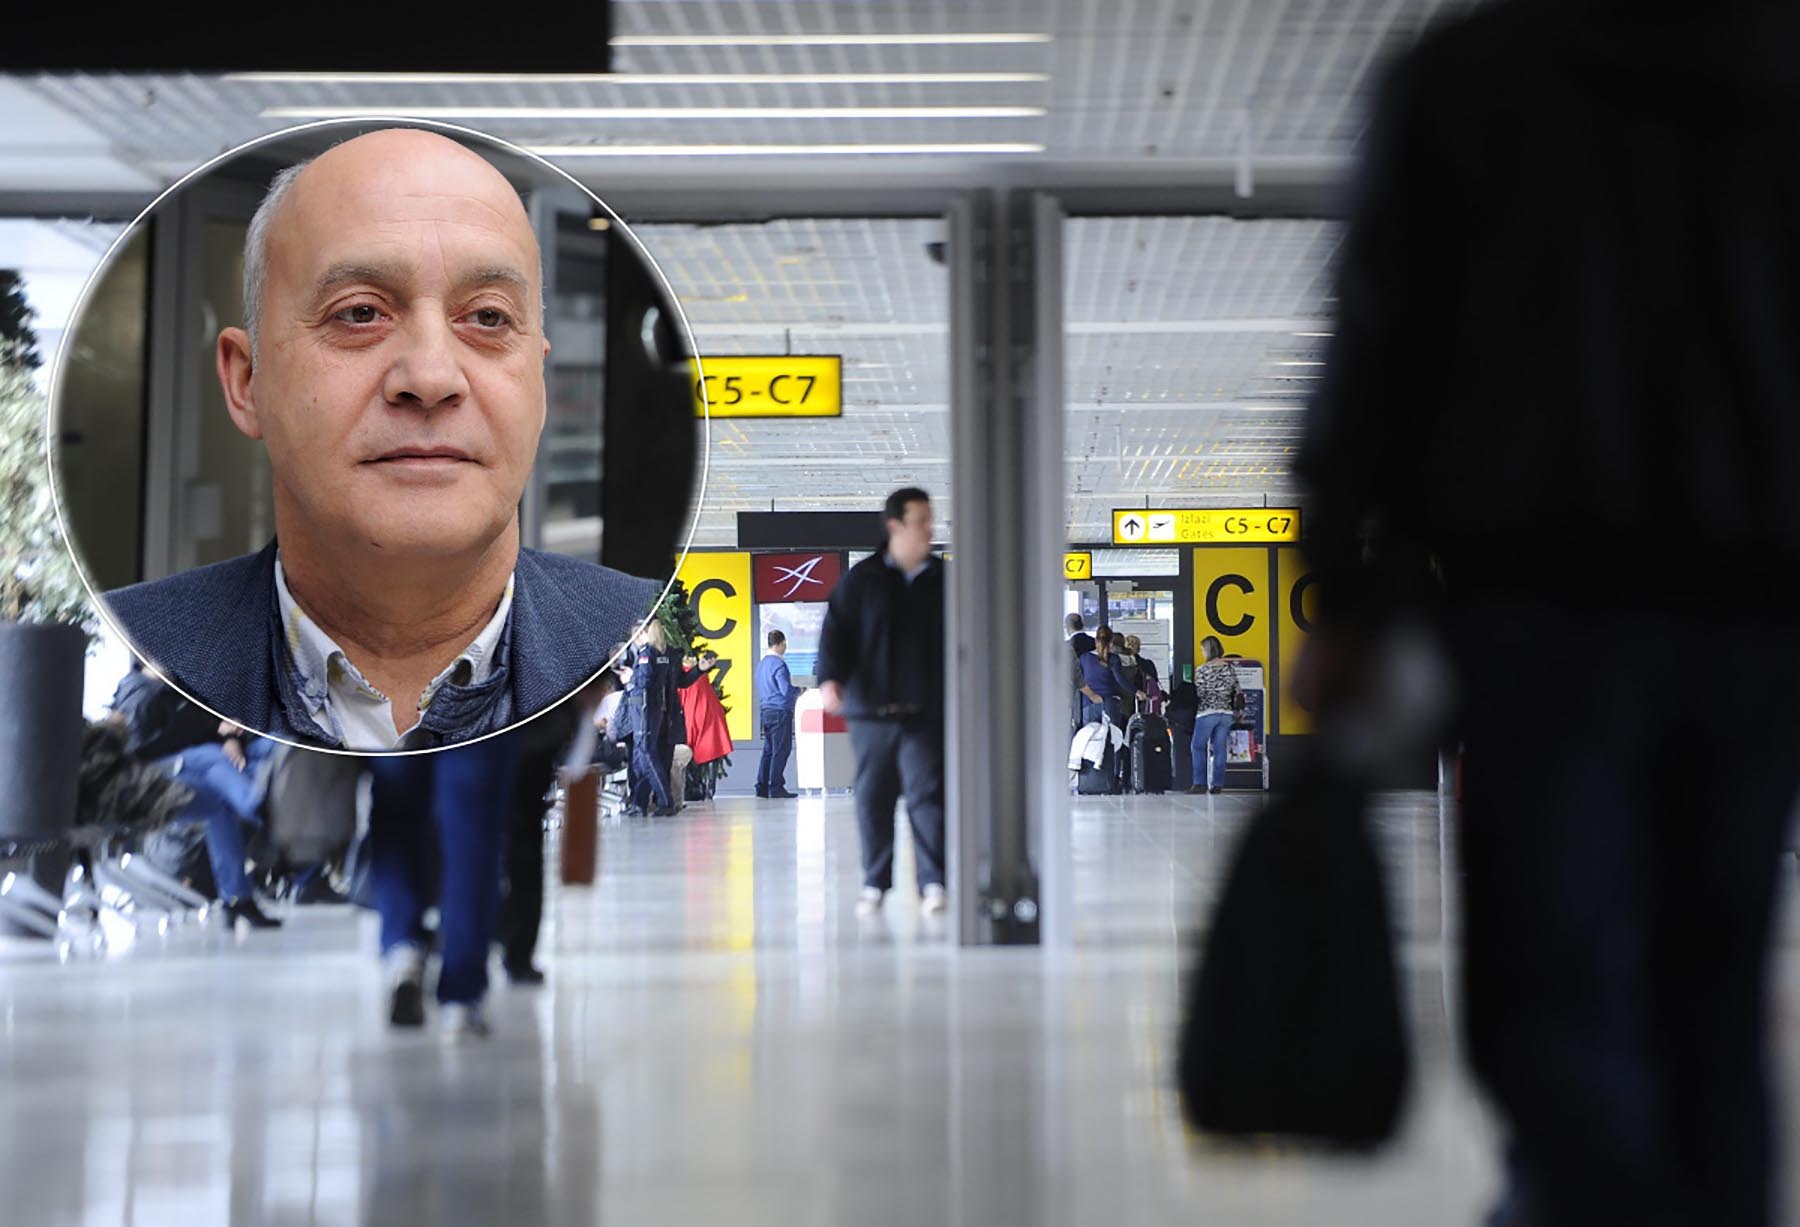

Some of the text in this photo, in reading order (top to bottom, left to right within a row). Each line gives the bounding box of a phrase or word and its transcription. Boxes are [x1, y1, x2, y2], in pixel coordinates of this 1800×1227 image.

[1065, 559, 1085, 572] C7
[687, 578, 737, 640] C
[1205, 574, 1255, 637] C
